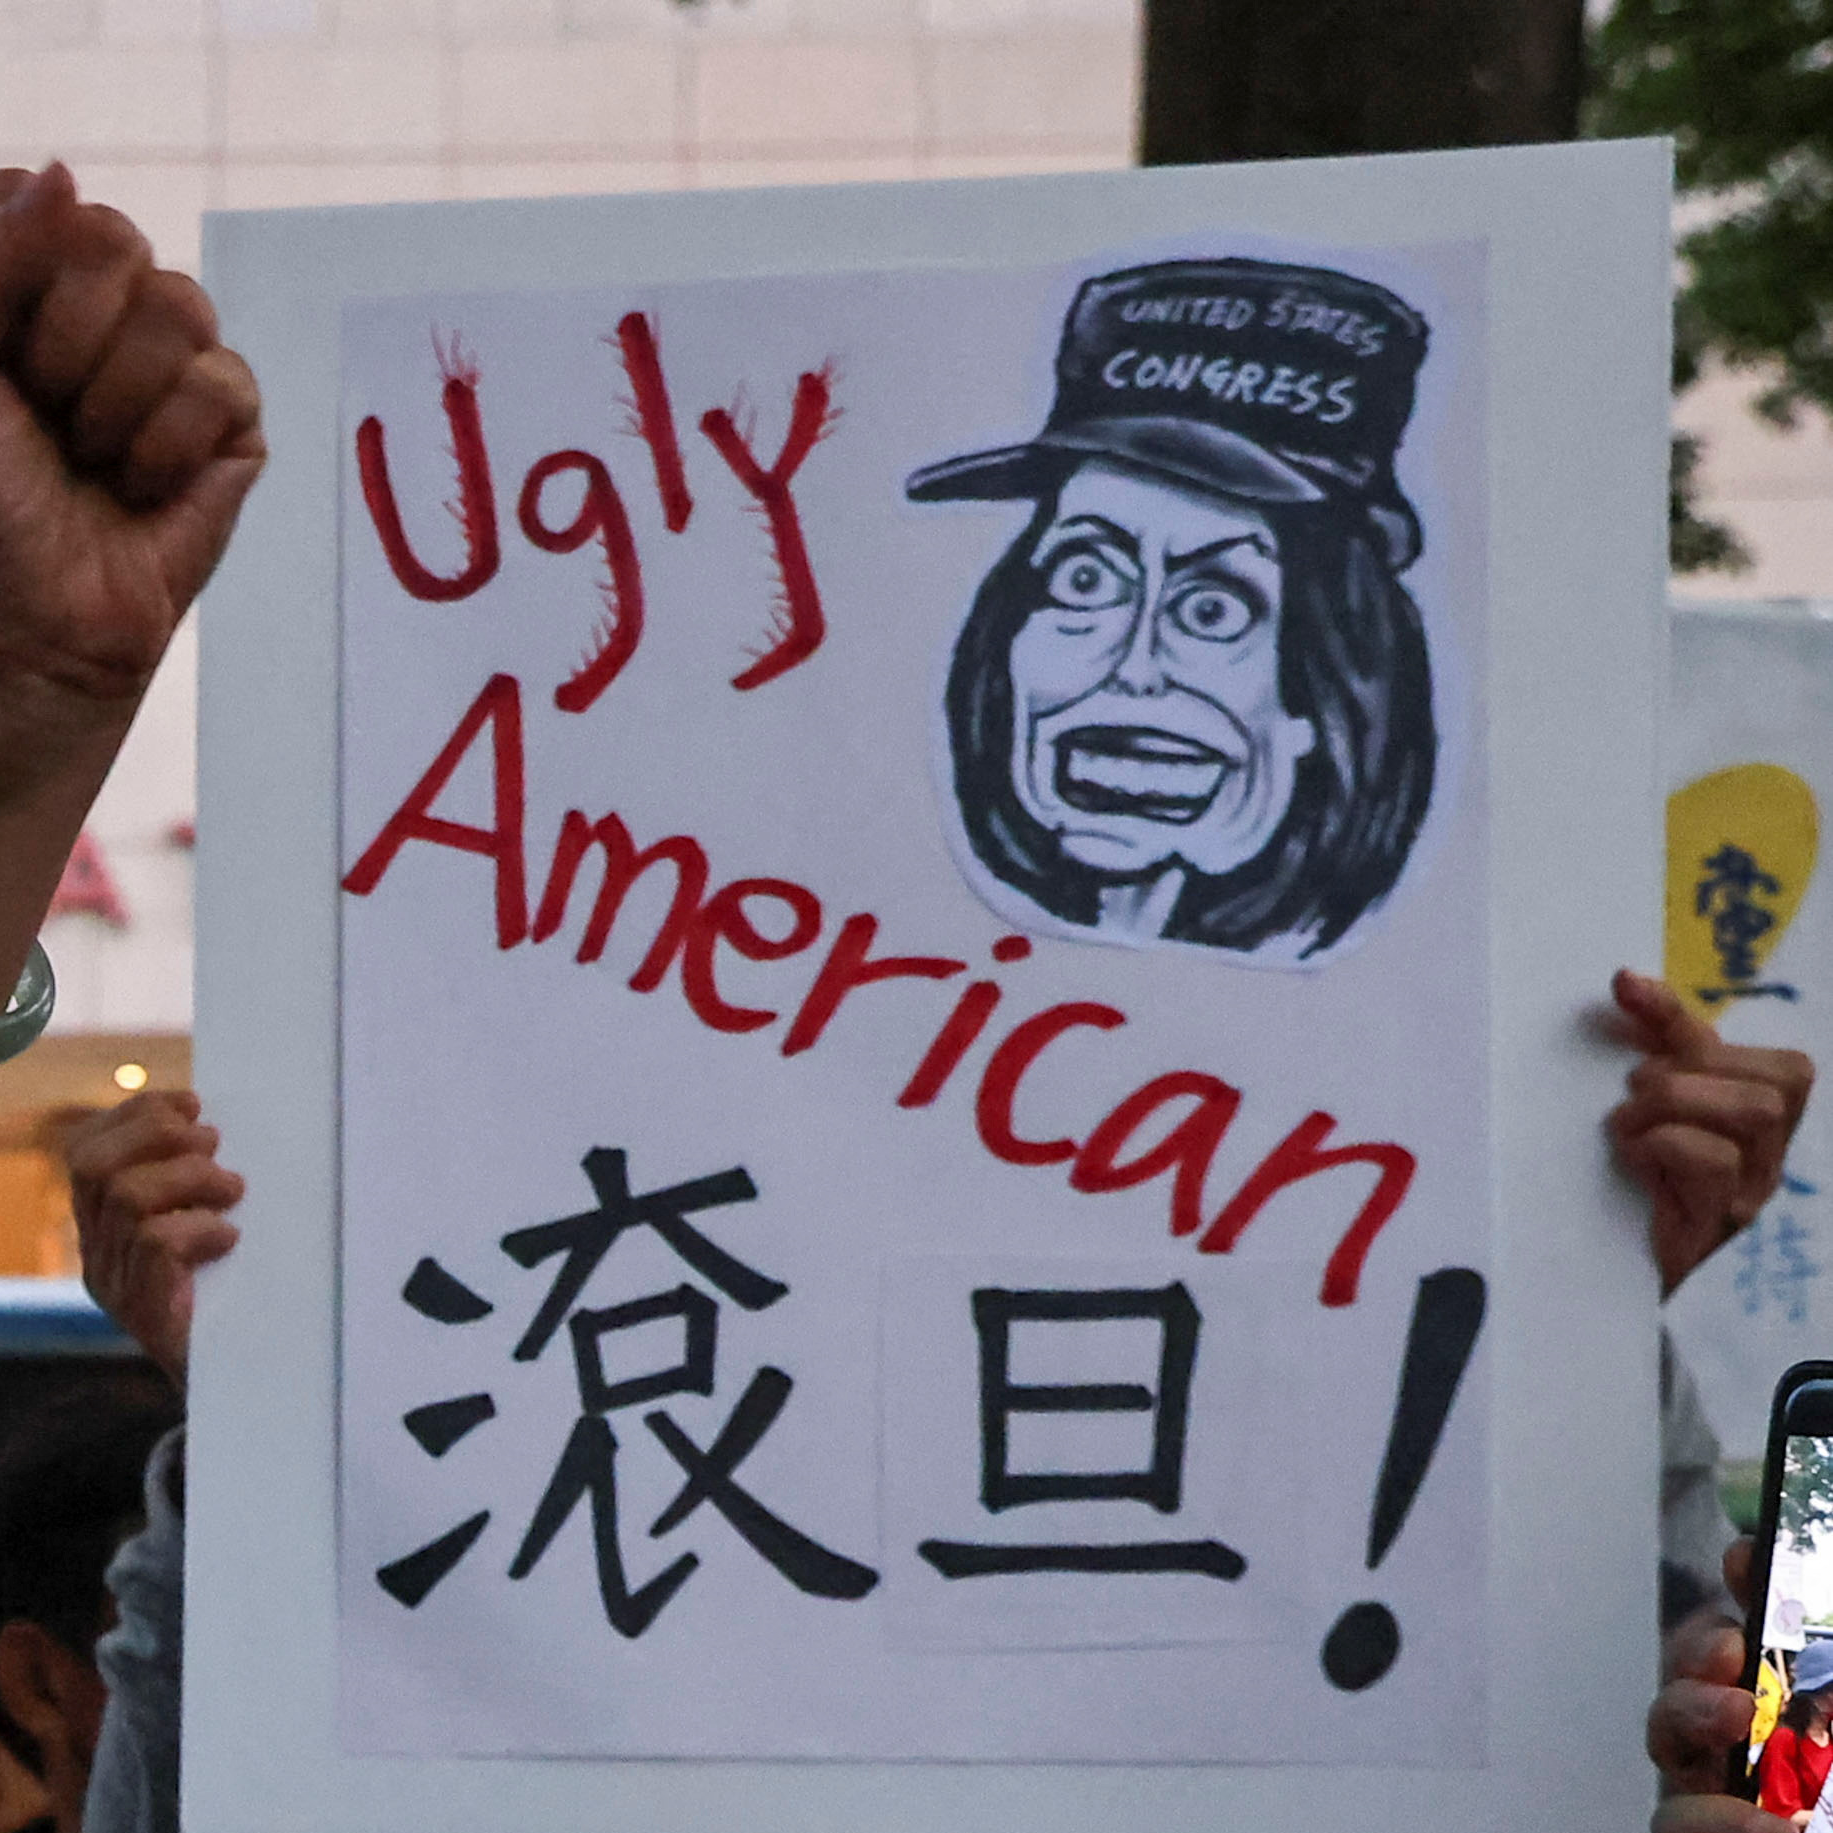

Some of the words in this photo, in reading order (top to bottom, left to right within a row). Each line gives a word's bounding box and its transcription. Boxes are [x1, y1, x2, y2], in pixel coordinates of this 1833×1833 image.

[1100, 347, 1356, 424] CONGRESS
[1119, 296, 1256, 330] UNITED
[1264, 289, 1385, 358] STATES
[355, 310, 838, 715] Ugly
[341, 673, 1416, 1307] American
